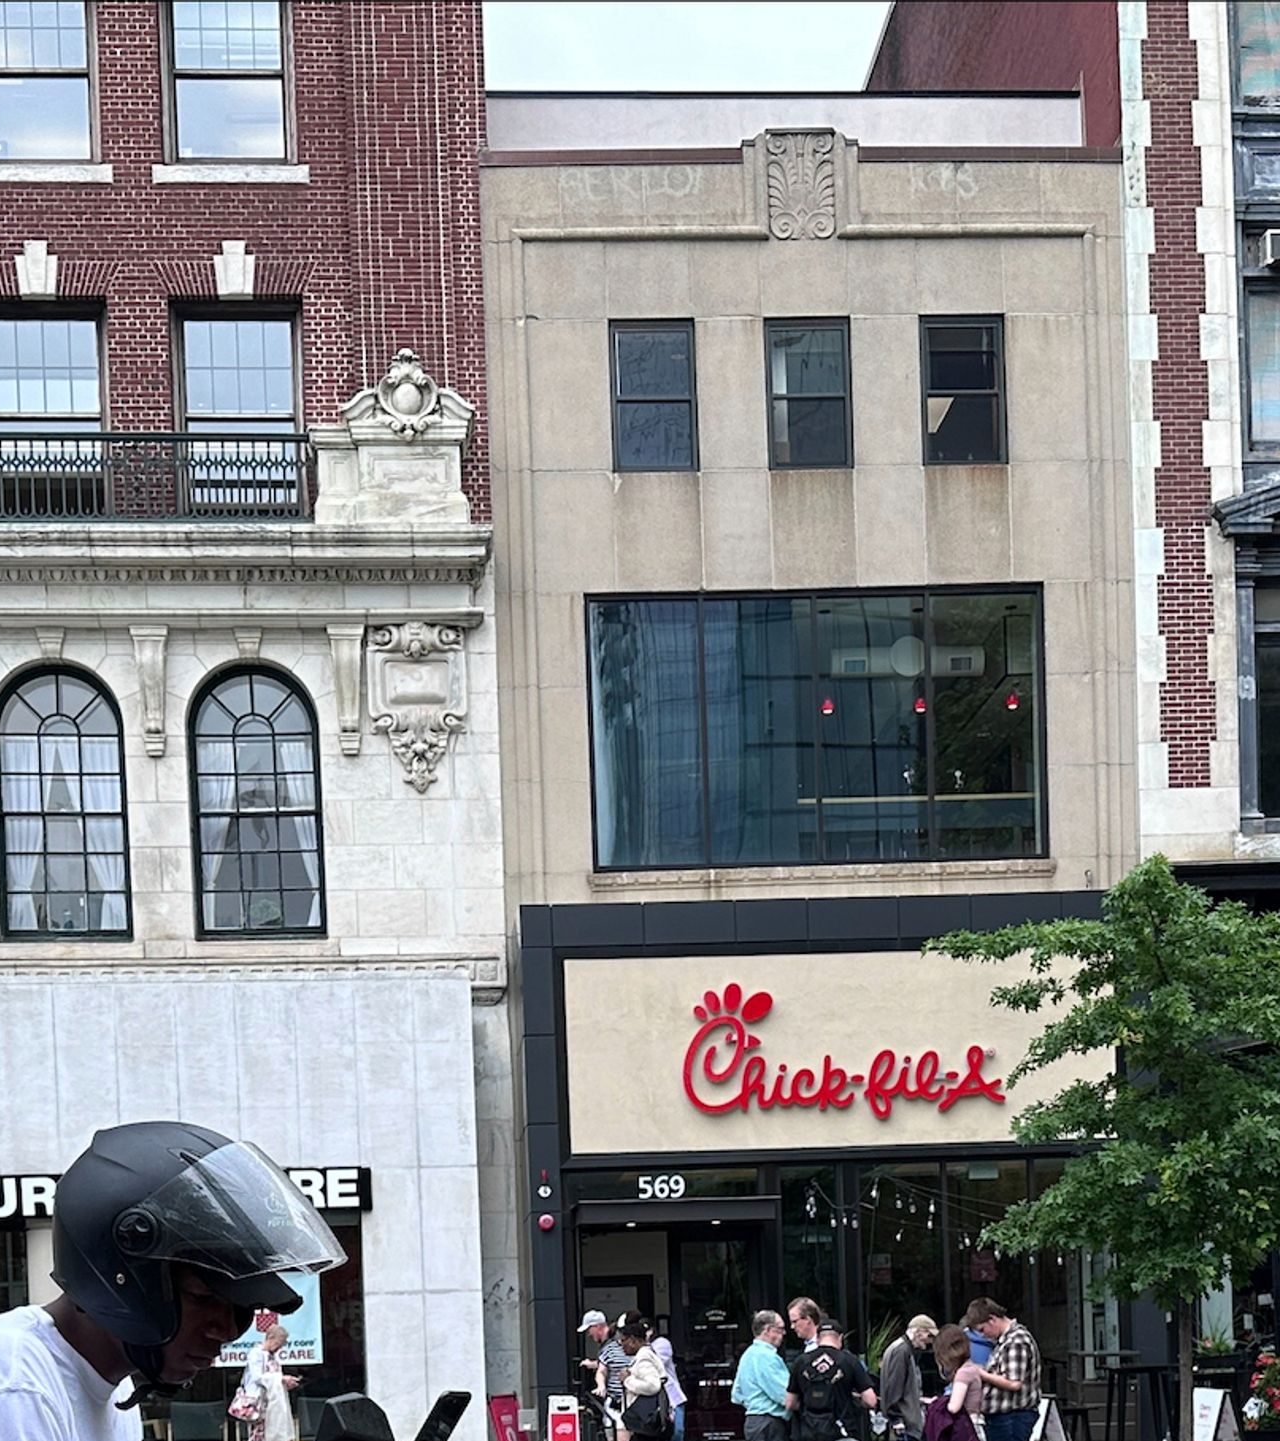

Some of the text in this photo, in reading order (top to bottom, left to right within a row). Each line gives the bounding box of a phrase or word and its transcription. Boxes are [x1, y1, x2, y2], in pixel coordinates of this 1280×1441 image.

[683, 1015, 1006, 1121] Chick-fil-A
[288, 1168, 361, 1209] RE
[638, 1174, 686, 1200] 569
[278, 1350, 316, 1361] CARE
